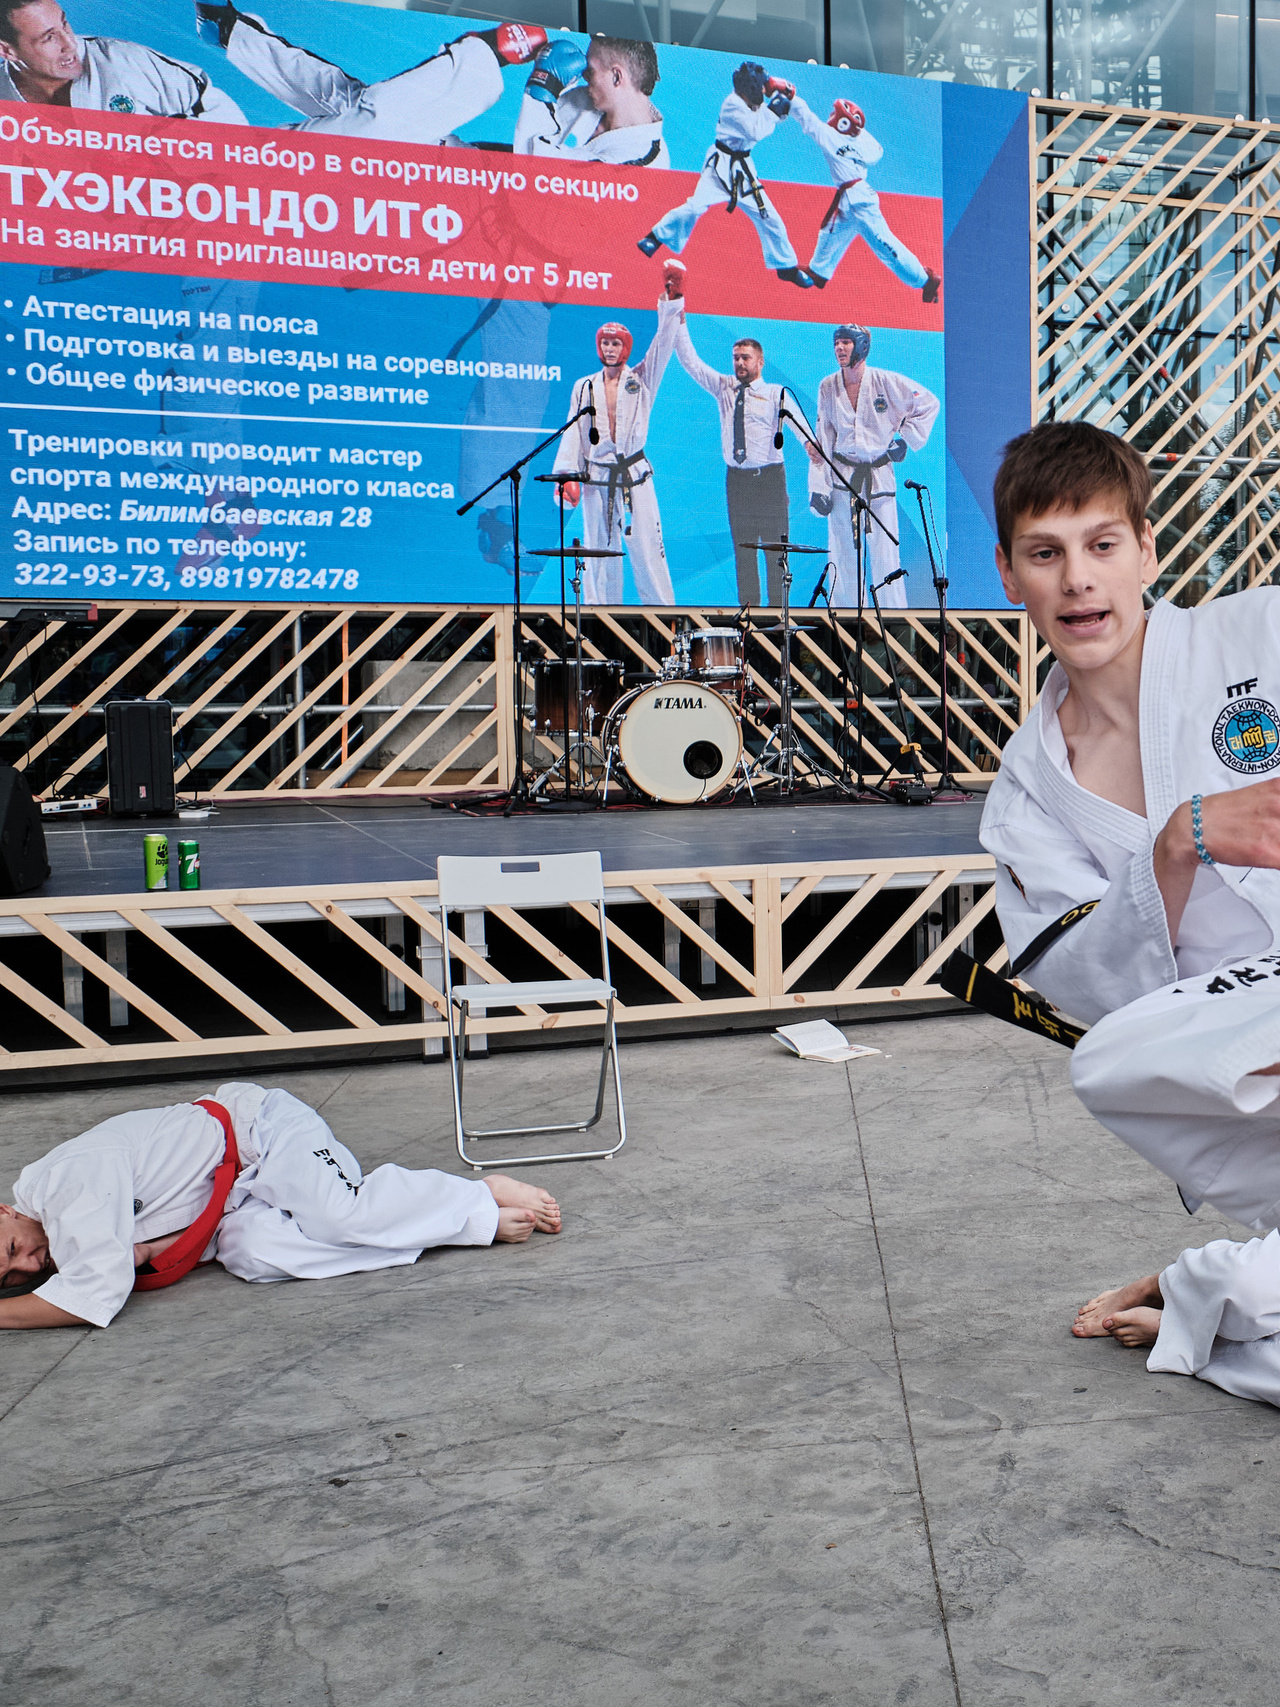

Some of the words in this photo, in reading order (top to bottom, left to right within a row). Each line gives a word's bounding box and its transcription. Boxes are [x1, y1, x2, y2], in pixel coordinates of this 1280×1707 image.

[0, 115, 212, 160] Объявляется
[225, 141, 315, 175] набор
[325, 155, 341, 172] в
[351, 157, 526, 194] спортивную
[535, 175, 638, 202] секцию
[0, 165, 339, 238] ТХЭКВОНДО
[354, 197, 462, 244] ИТФ
[2, 218, 45, 246] На
[55, 229, 185, 257] занятия
[197, 240, 419, 275] приглашаются
[428, 259, 495, 282] дети
[504, 265, 535, 284] от
[544, 263, 558, 286] 5
[566, 270, 612, 290] лет
[23, 296, 190, 329] Аттестация
[200, 312, 231, 329] на
[240, 315, 317, 335] пояса
[25, 329, 194, 360] Подготовка
[204, 345, 218, 361] и
[228, 347, 337, 371] выезды
[347, 354, 376, 370] на
[385, 357, 560, 380] соревнования
[27, 363, 125, 391] Общее
[134, 369, 299, 398] физическое
[309, 384, 428, 404] развитие
[9, 429, 182, 459] Тренировки
[192, 443, 320, 465] проводит
[330, 449, 421, 471] мастер
[11, 468, 110, 491] спорта
[121, 472, 358, 497] международного
[367, 481, 454, 498] класса
[12, 497, 112, 524] Адрес:
[120, 500, 332, 526] Билимбаевская
[341, 507, 371, 527] 28
[14, 530, 118, 553] Запись
[127, 538, 159, 554] по
[168, 535, 307, 562] телефону:
[15, 563, 170, 590] 322-93-73,
[181, 566, 358, 589] 89819782478
[663, 697, 704, 709] TAMA
[1226, 677, 1258, 698] ITF
